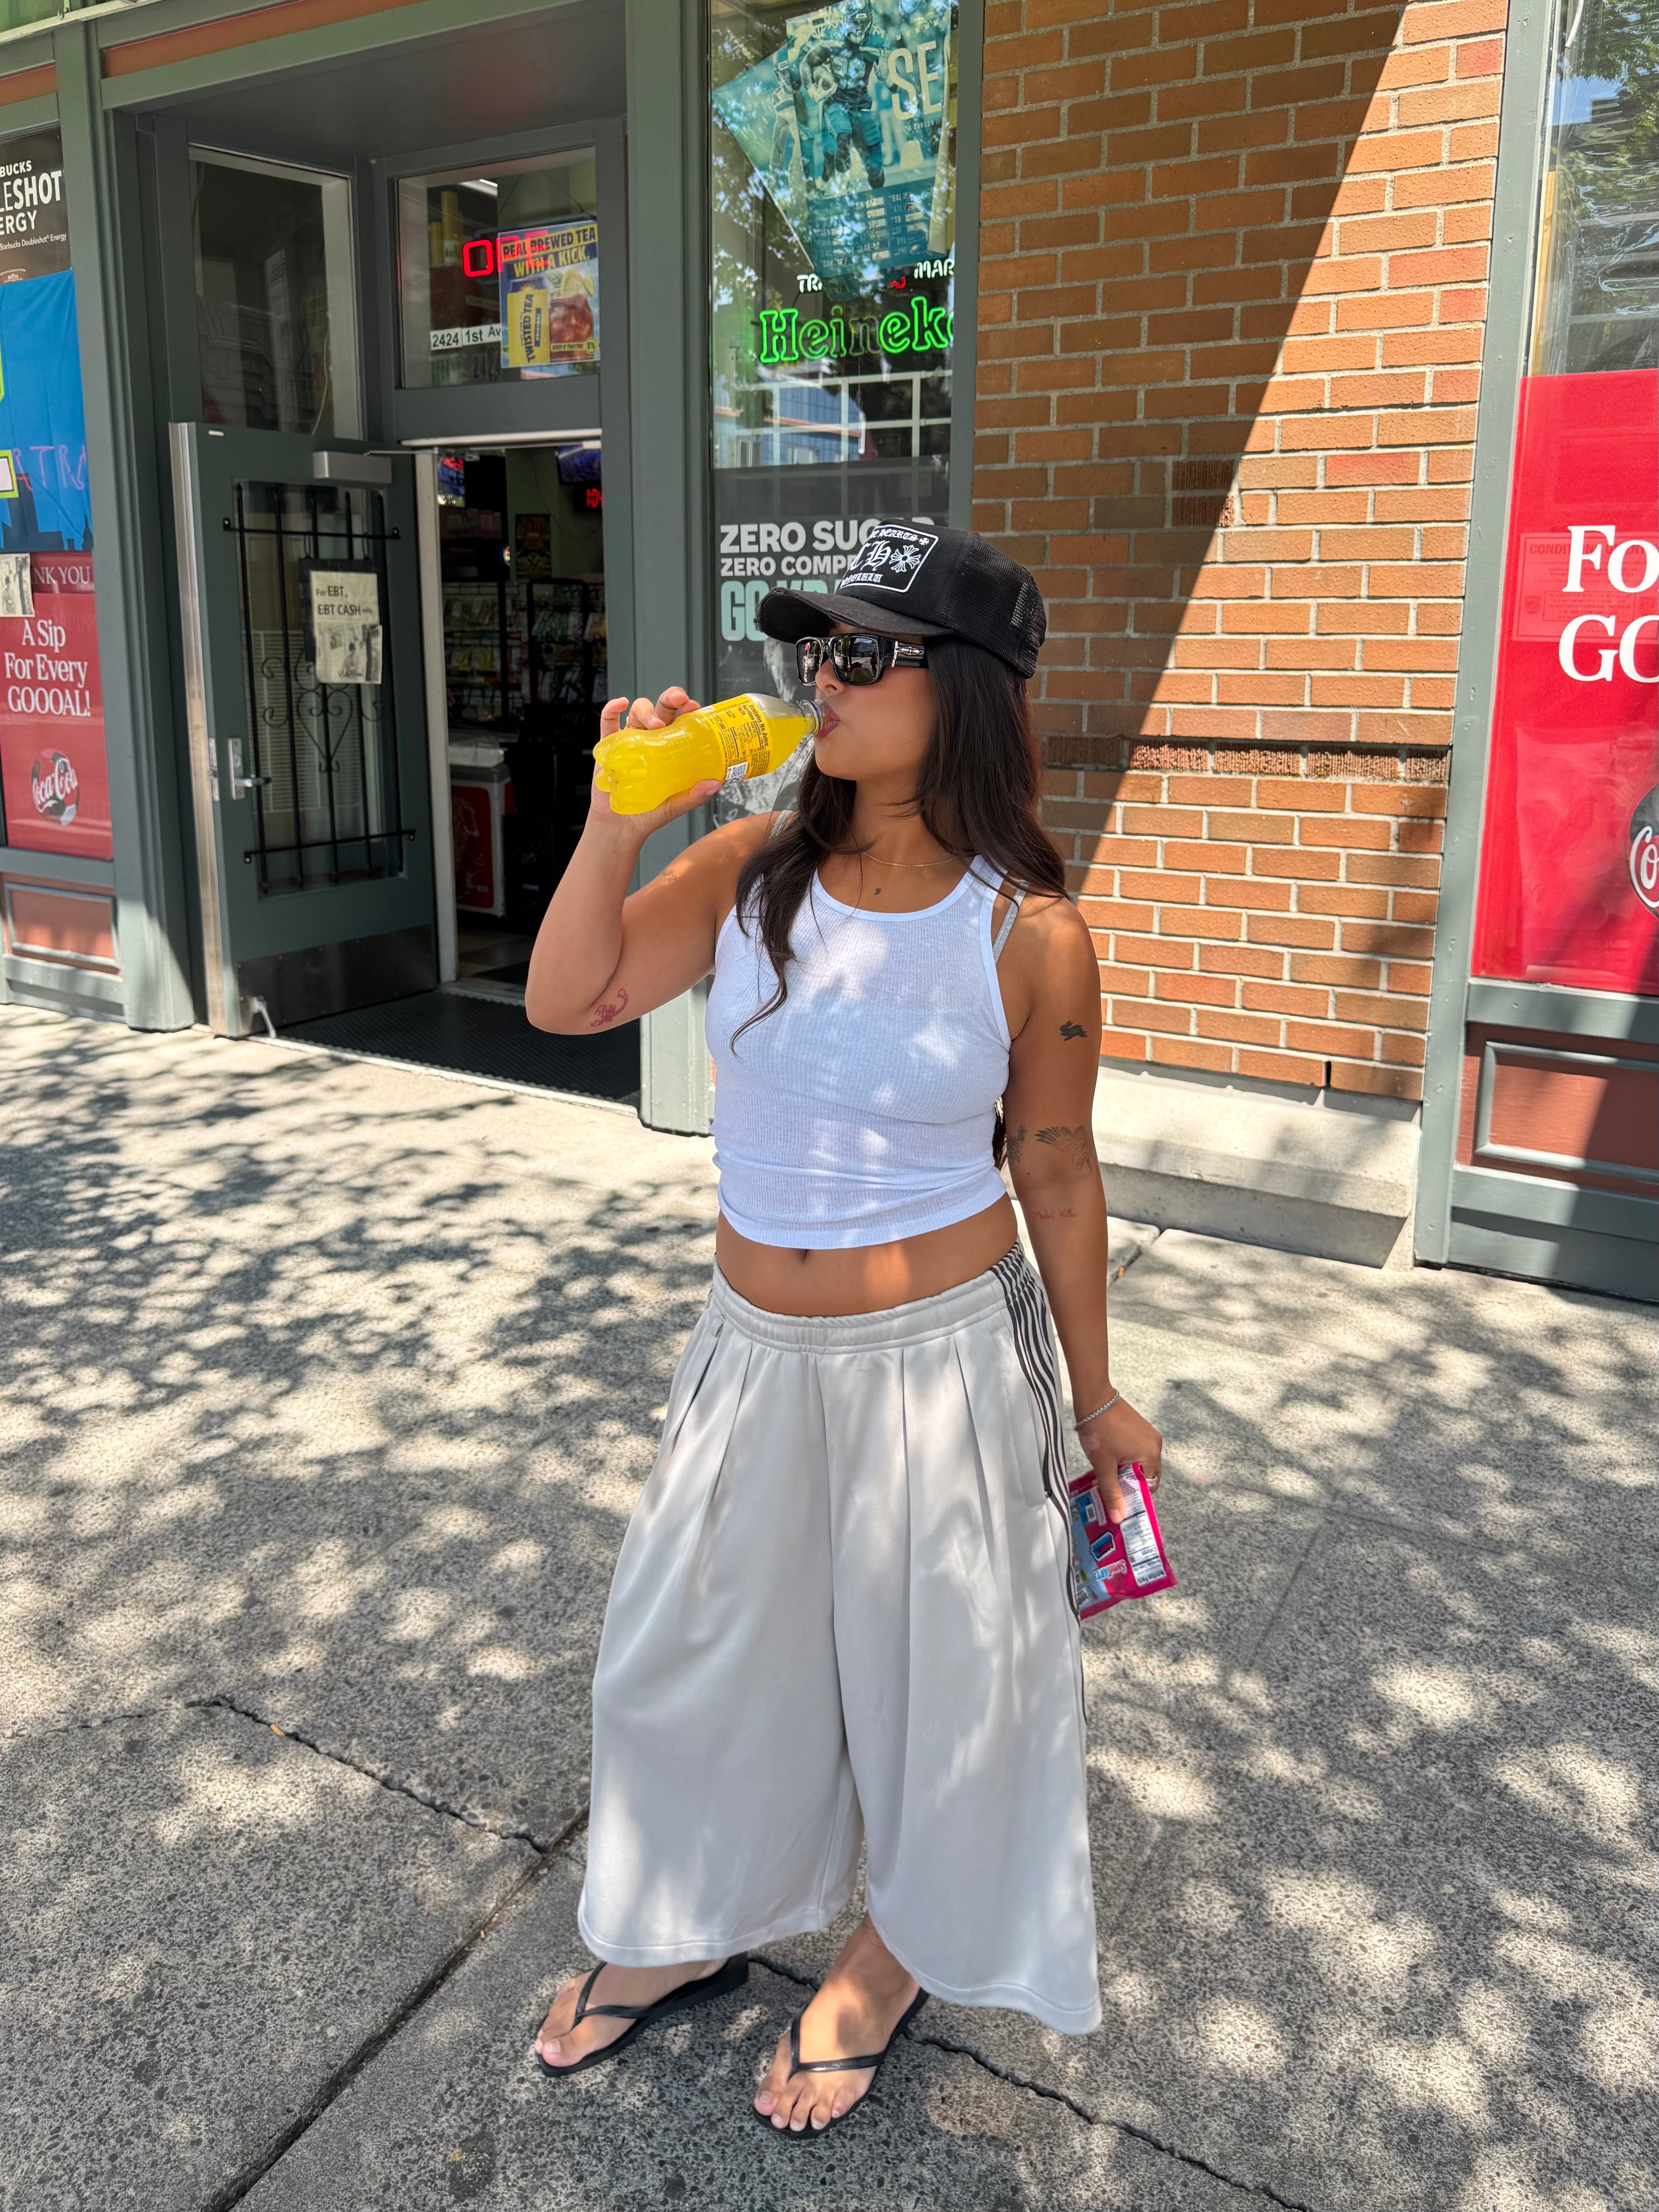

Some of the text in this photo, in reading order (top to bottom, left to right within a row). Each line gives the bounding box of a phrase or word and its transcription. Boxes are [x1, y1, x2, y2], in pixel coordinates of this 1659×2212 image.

[0, 160, 32, 178] BUCKS
[50, 234, 66, 242] Energy
[575, 227, 596, 243] TEA
[547, 253, 556, 269] A
[432, 331, 459, 347] 2424
[465, 328, 483, 343] 1st
[523, 294, 535, 362] TWISTED TEA
[720, 522, 806, 553] ZERO
[721, 557, 776, 576] ZERO
[1562, 525, 1659, 593] Fo
[33, 565, 90, 585] NK YOU
[318, 604, 335, 615] EBT
[338, 604, 361, 616] CASH
[22, 619, 66, 653] A Sip
[4, 652, 88, 689] For Every
[8, 685, 91, 717] GOOOAL!
[750, 704, 762, 723] Contains
[1630, 826, 1659, 909] Co
